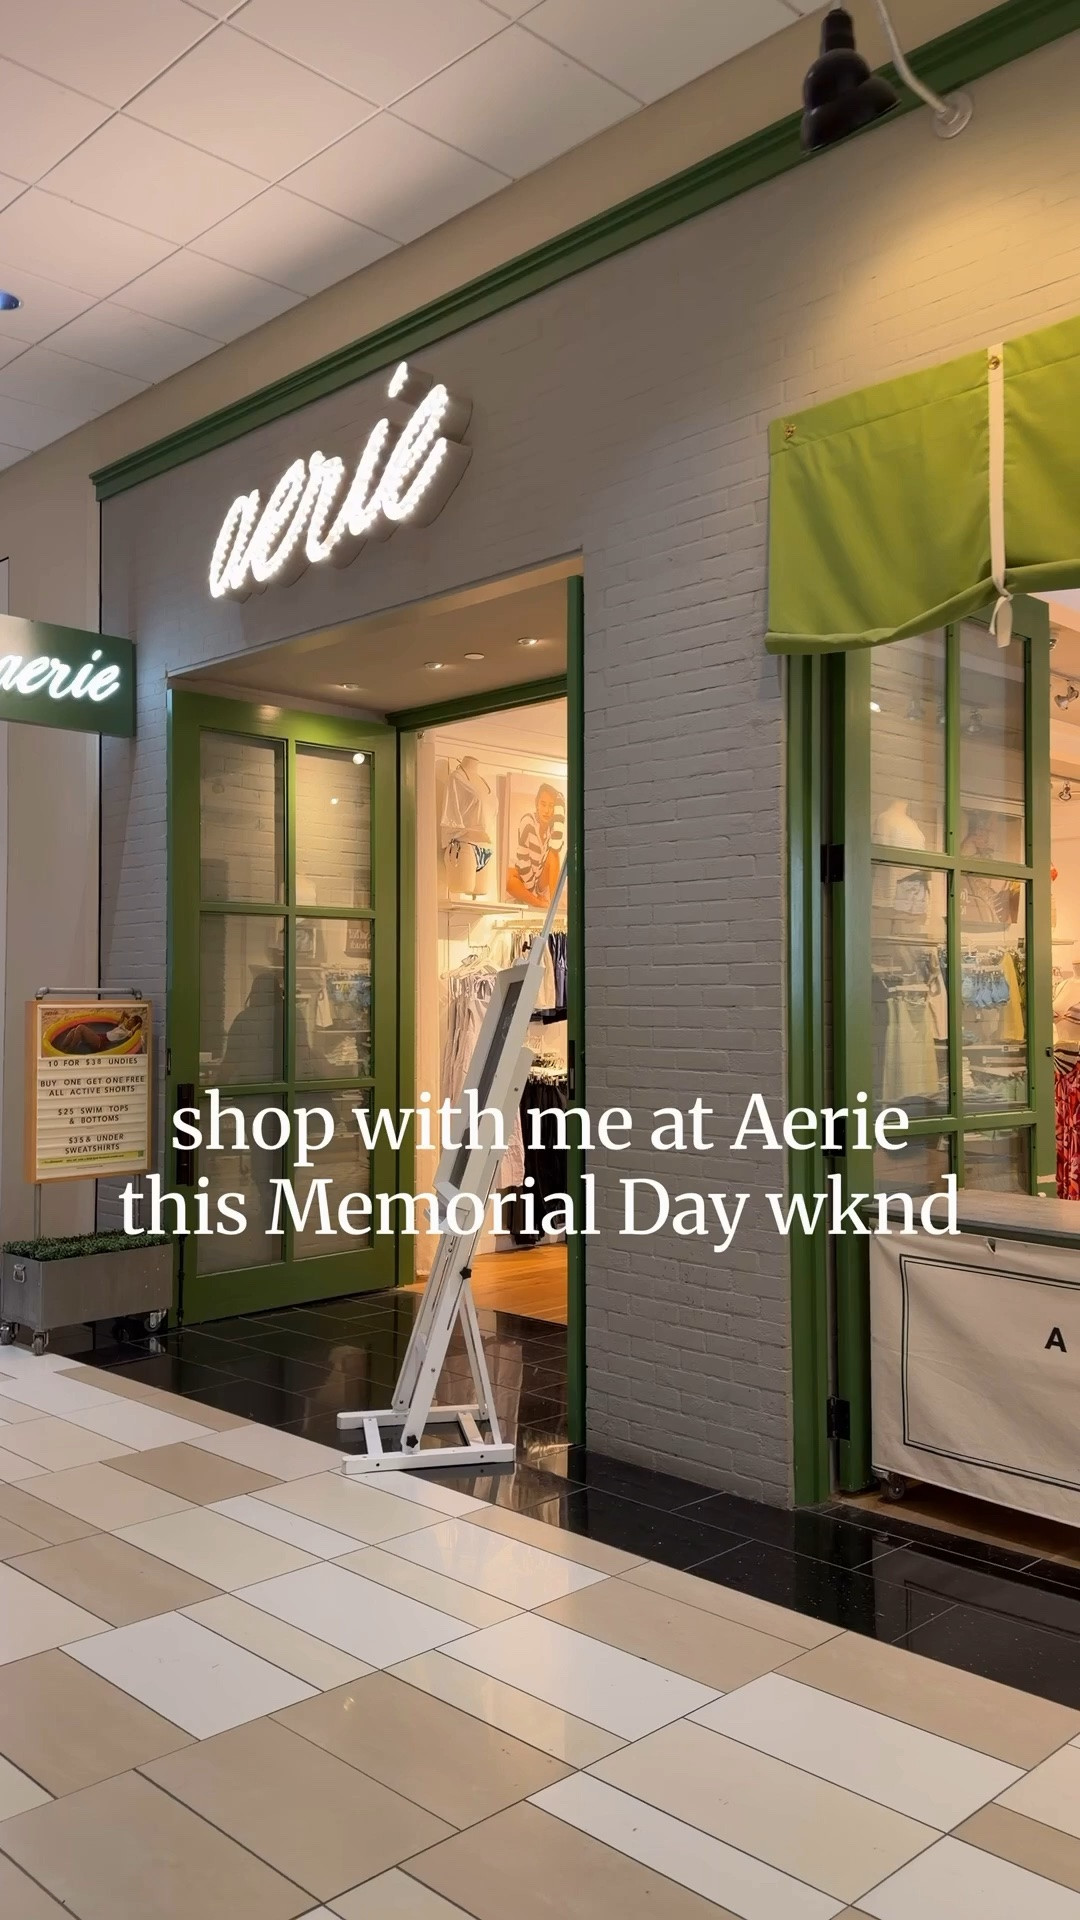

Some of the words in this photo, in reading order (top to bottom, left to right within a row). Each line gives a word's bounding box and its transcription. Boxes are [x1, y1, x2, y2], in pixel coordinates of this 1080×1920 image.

[208, 361, 449, 599] aerie
[63, 1059, 80, 1067] FOR
[85, 1058, 102, 1066] $38
[108, 1057, 138, 1065] UNDIES
[40, 1079, 57, 1088] BUY
[63, 1078, 81, 1086] ONE
[86, 1077, 102, 1086] GET
[105, 1076, 124, 1085] ONE
[125, 1075, 145, 1083] FREE
[48, 1089, 65, 1097] ALL
[70, 1087, 101, 1096] ACTIVE
[104, 1085, 136, 1094] SHORTS
[58, 1107, 74, 1116] $25
[80, 1106, 103, 1115] SWIM
[108, 1104, 129, 1112] TOPS
[69, 1117, 75, 1125] &
[80, 1114, 120, 1124] BOTTOMS
[96, 1133, 124, 1142] UNDER
[65, 1143, 120, 1155] SWEATSHIRTS
[1044, 1326, 1068, 1354] A
